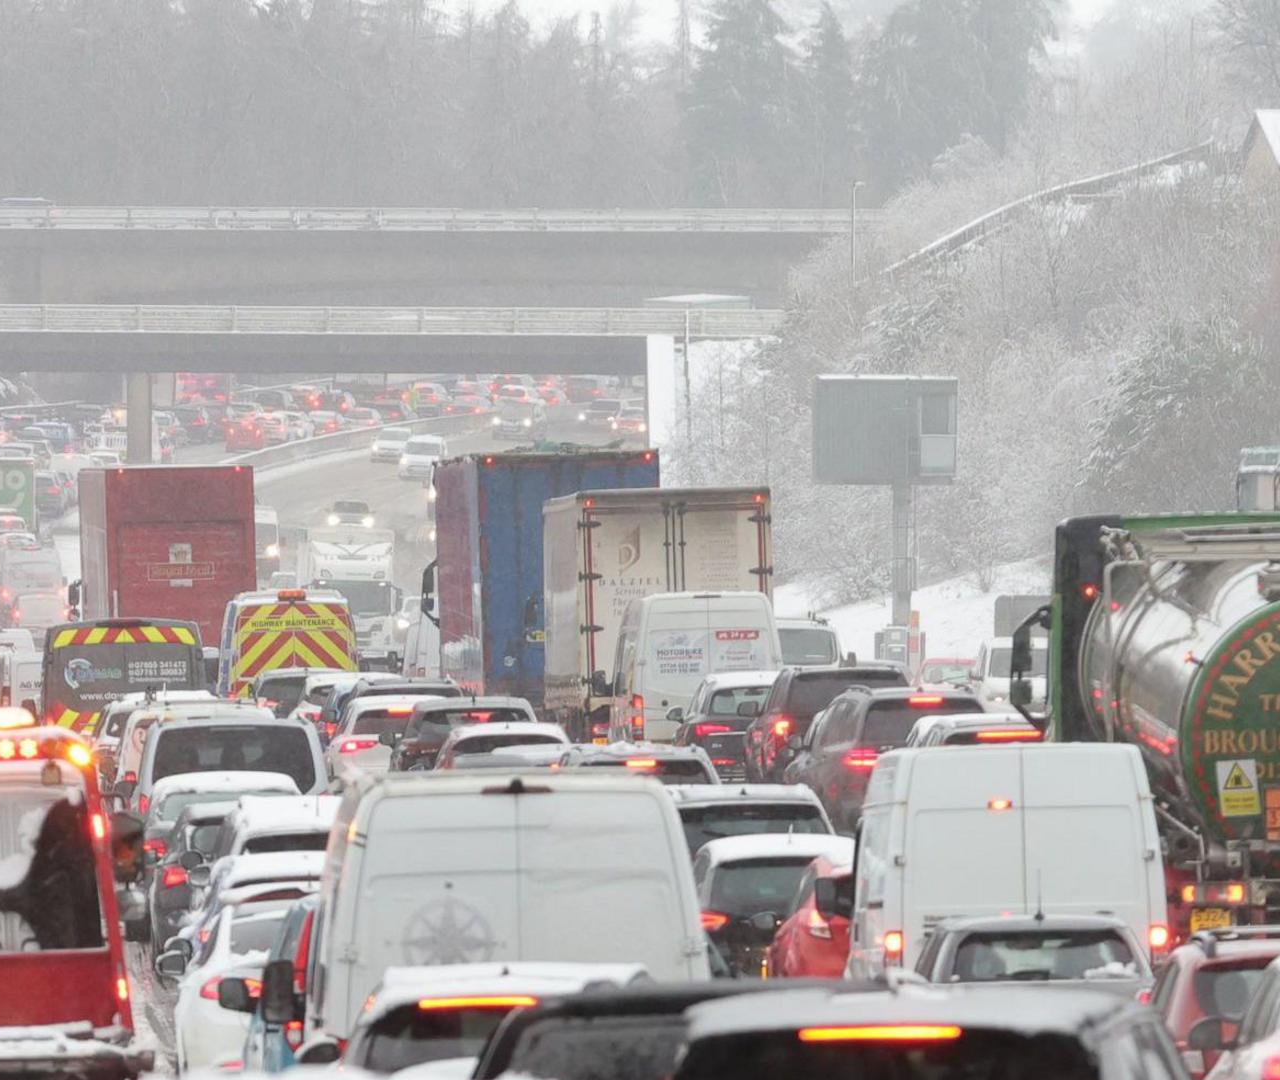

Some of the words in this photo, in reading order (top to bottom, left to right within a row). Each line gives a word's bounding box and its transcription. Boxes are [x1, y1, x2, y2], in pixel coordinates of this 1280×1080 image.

[598, 577, 662, 586] DALZIEL
[251, 620, 282, 628] HIGHWAY
[285, 618, 336, 627] MAINTENANCE
